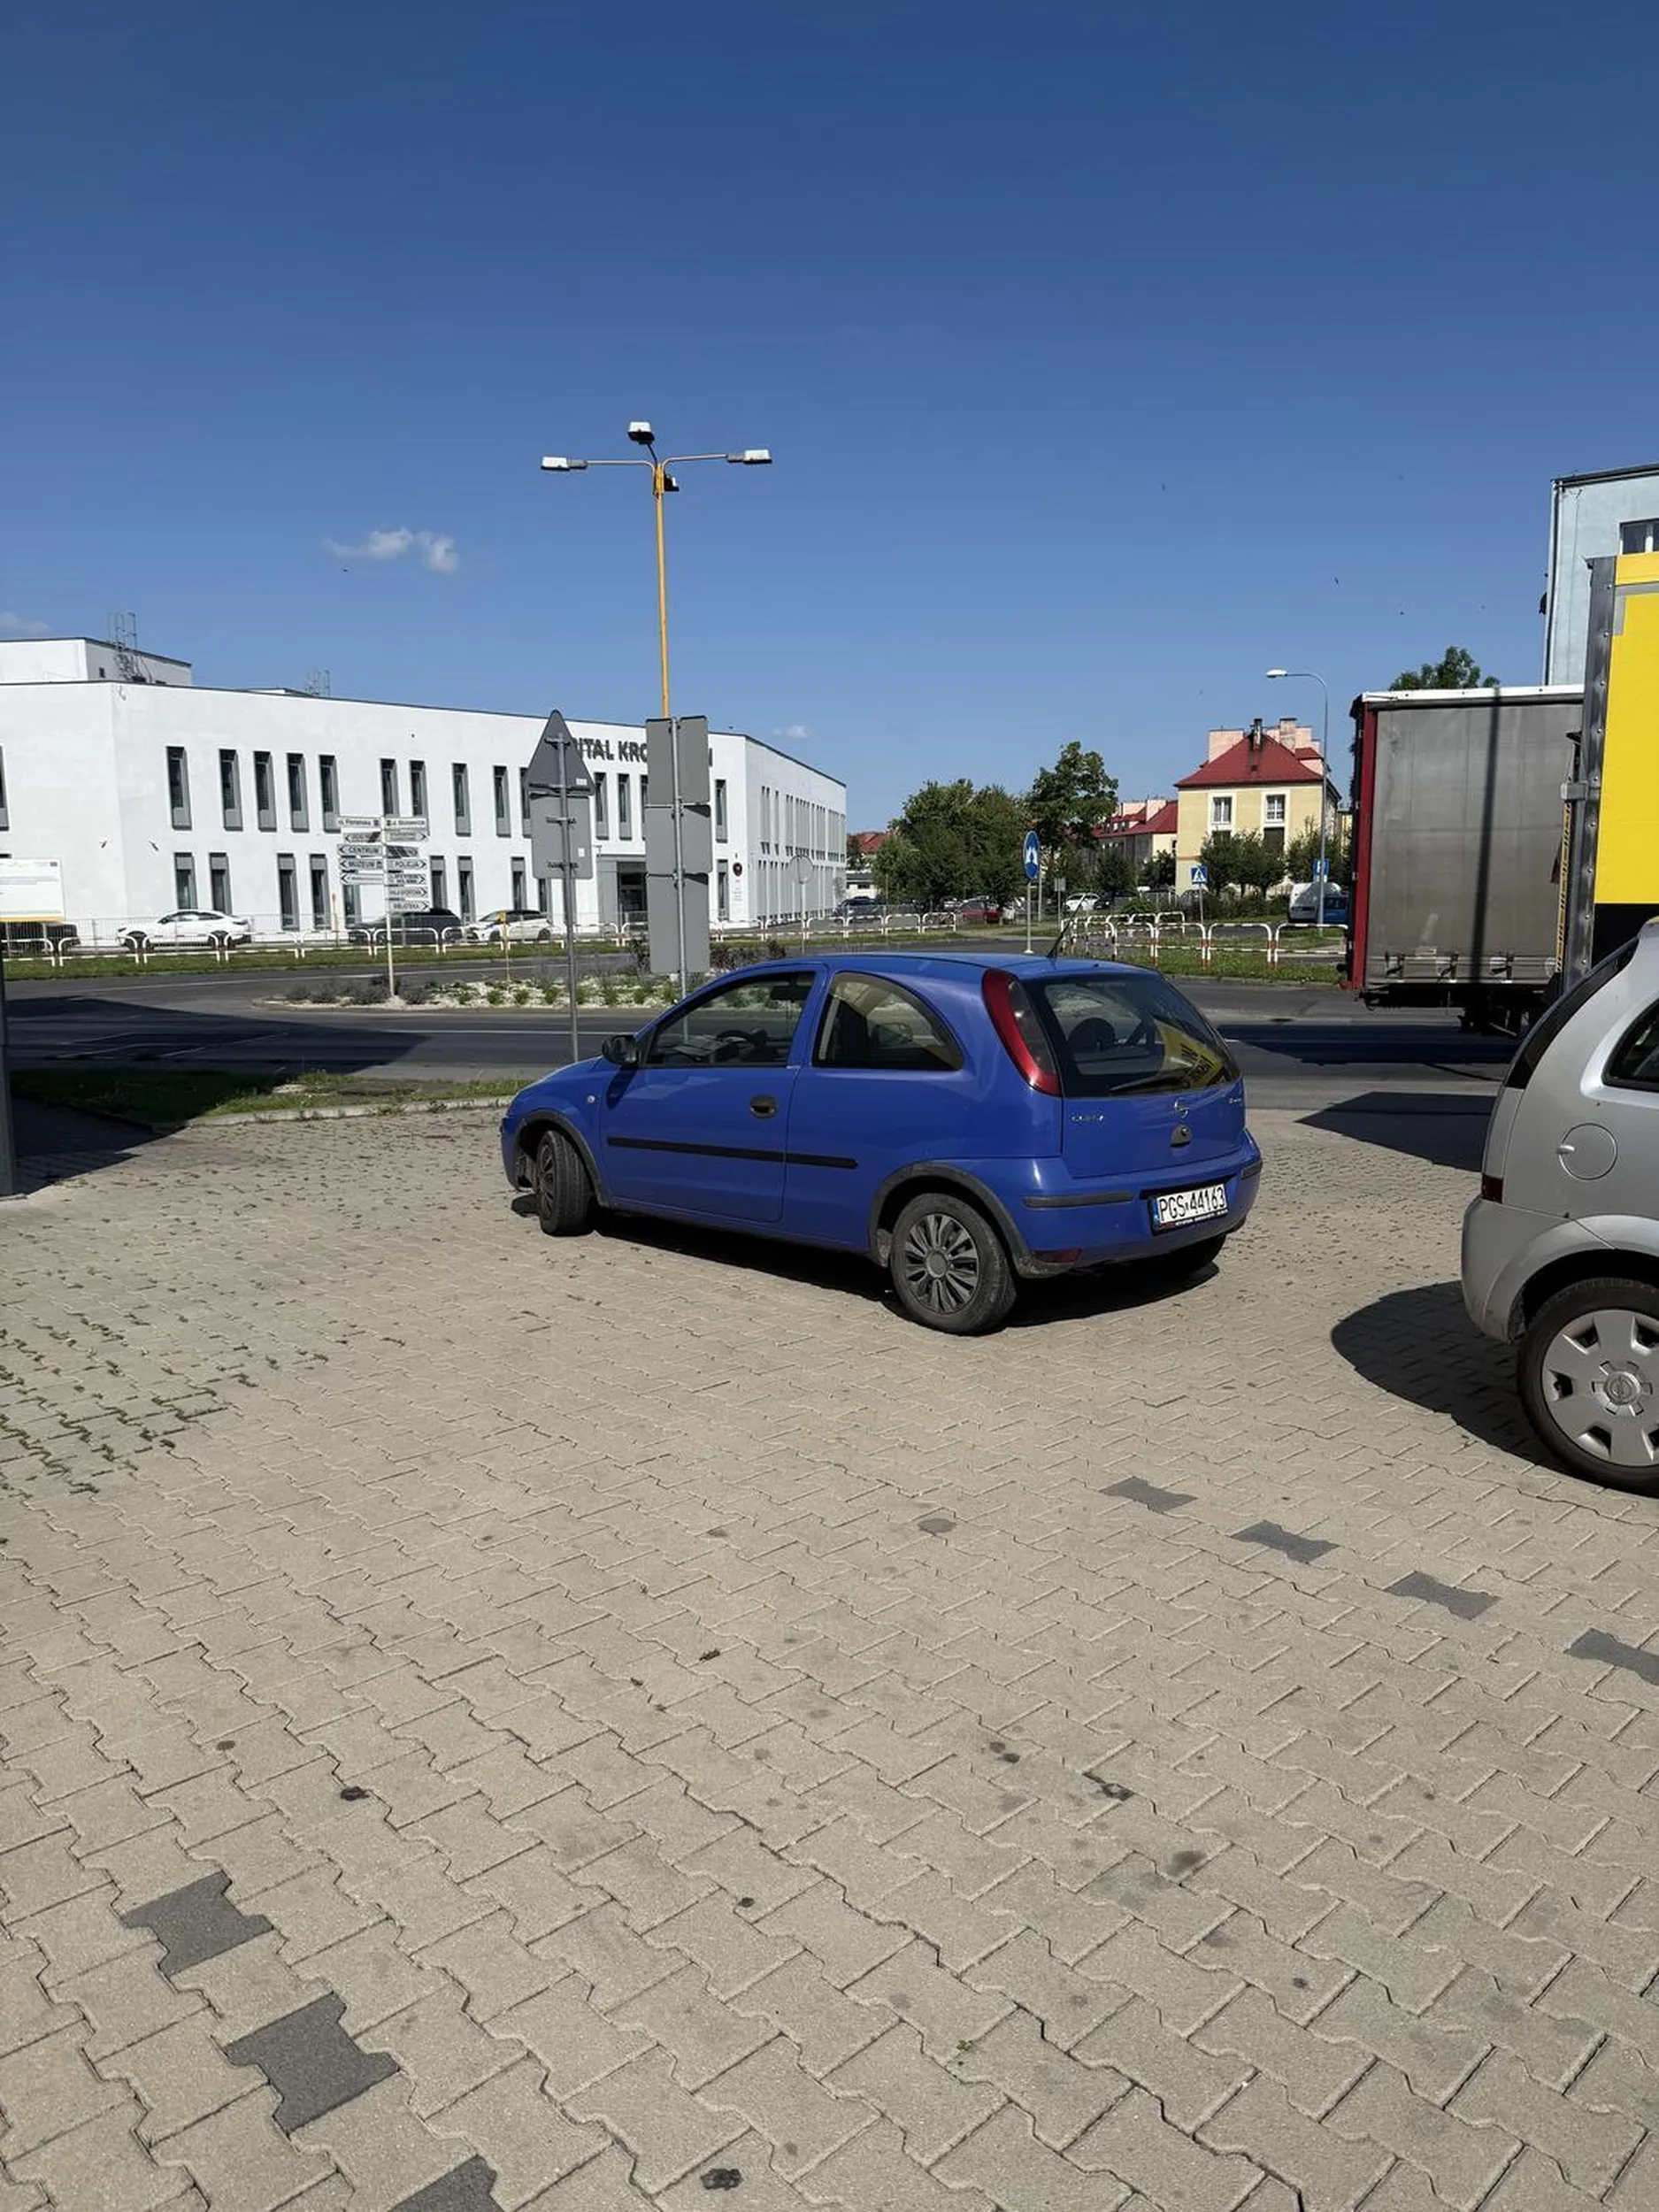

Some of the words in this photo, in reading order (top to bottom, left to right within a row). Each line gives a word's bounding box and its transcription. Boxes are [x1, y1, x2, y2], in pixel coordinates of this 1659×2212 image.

[349, 845, 380, 854] CENTRUM
[1159, 1194, 1187, 1222] PGS
[1190, 1187, 1225, 1213] 44163
